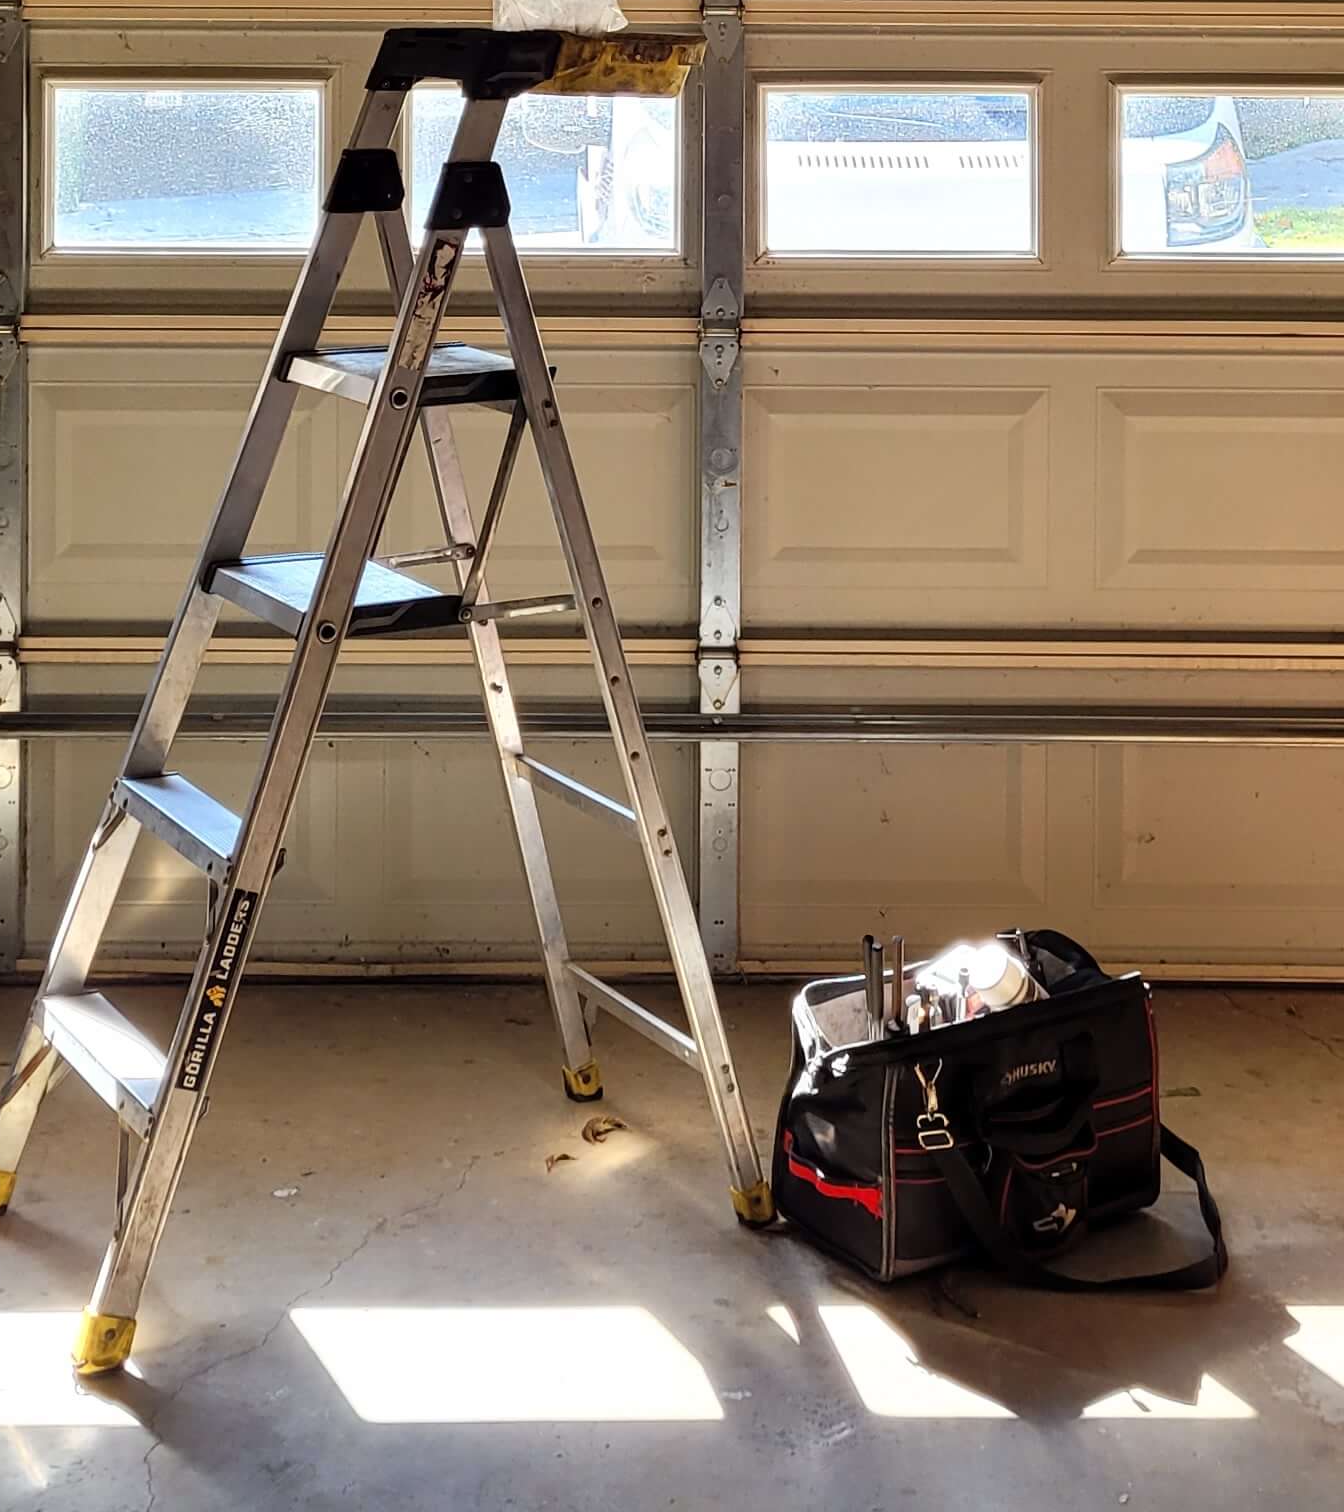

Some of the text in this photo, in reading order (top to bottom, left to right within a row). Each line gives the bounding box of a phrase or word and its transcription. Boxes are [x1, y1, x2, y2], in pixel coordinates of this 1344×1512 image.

[183, 899, 250, 1088] GORILLA LADDERS
[1011, 1059, 1057, 1083] HUSKY
